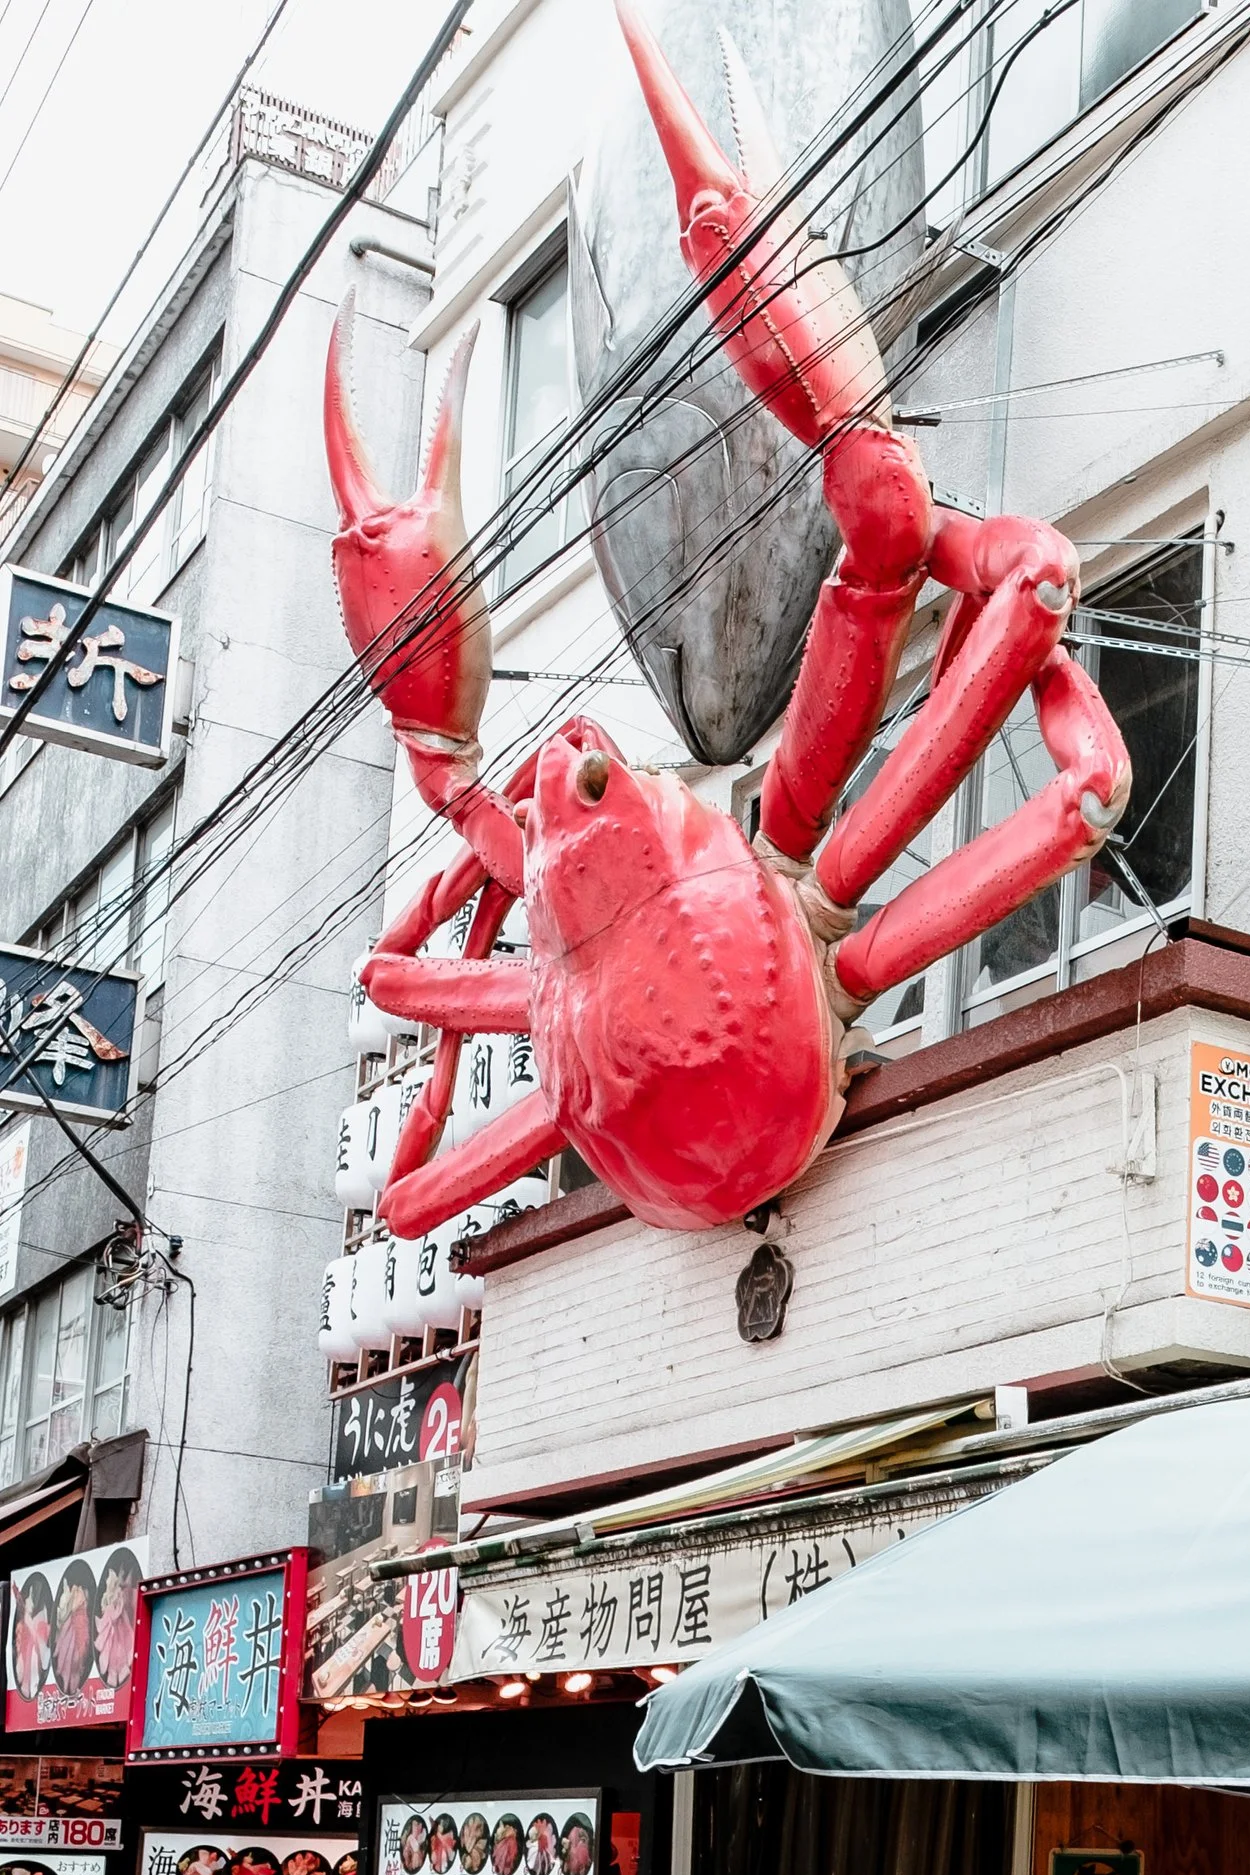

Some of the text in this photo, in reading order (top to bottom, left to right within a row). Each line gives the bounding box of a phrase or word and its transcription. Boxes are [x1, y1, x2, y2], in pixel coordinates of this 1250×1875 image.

[1196, 1271, 1205, 1280] 12
[1208, 1273, 1234, 1286] foreign
[1196, 1280, 1205, 1288] to
[1208, 1283, 1244, 1297] exchange
[344, 1376, 417, 1465] うに虎
[481, 1564, 713, 1663] 海産物問屋
[154, 1590, 283, 1719] 海鮮丼
[179, 1765, 337, 1825] 海鮮丼
[47, 1819, 59, 1844] 店内
[56, 1860, 101, 1873] おすすめ
